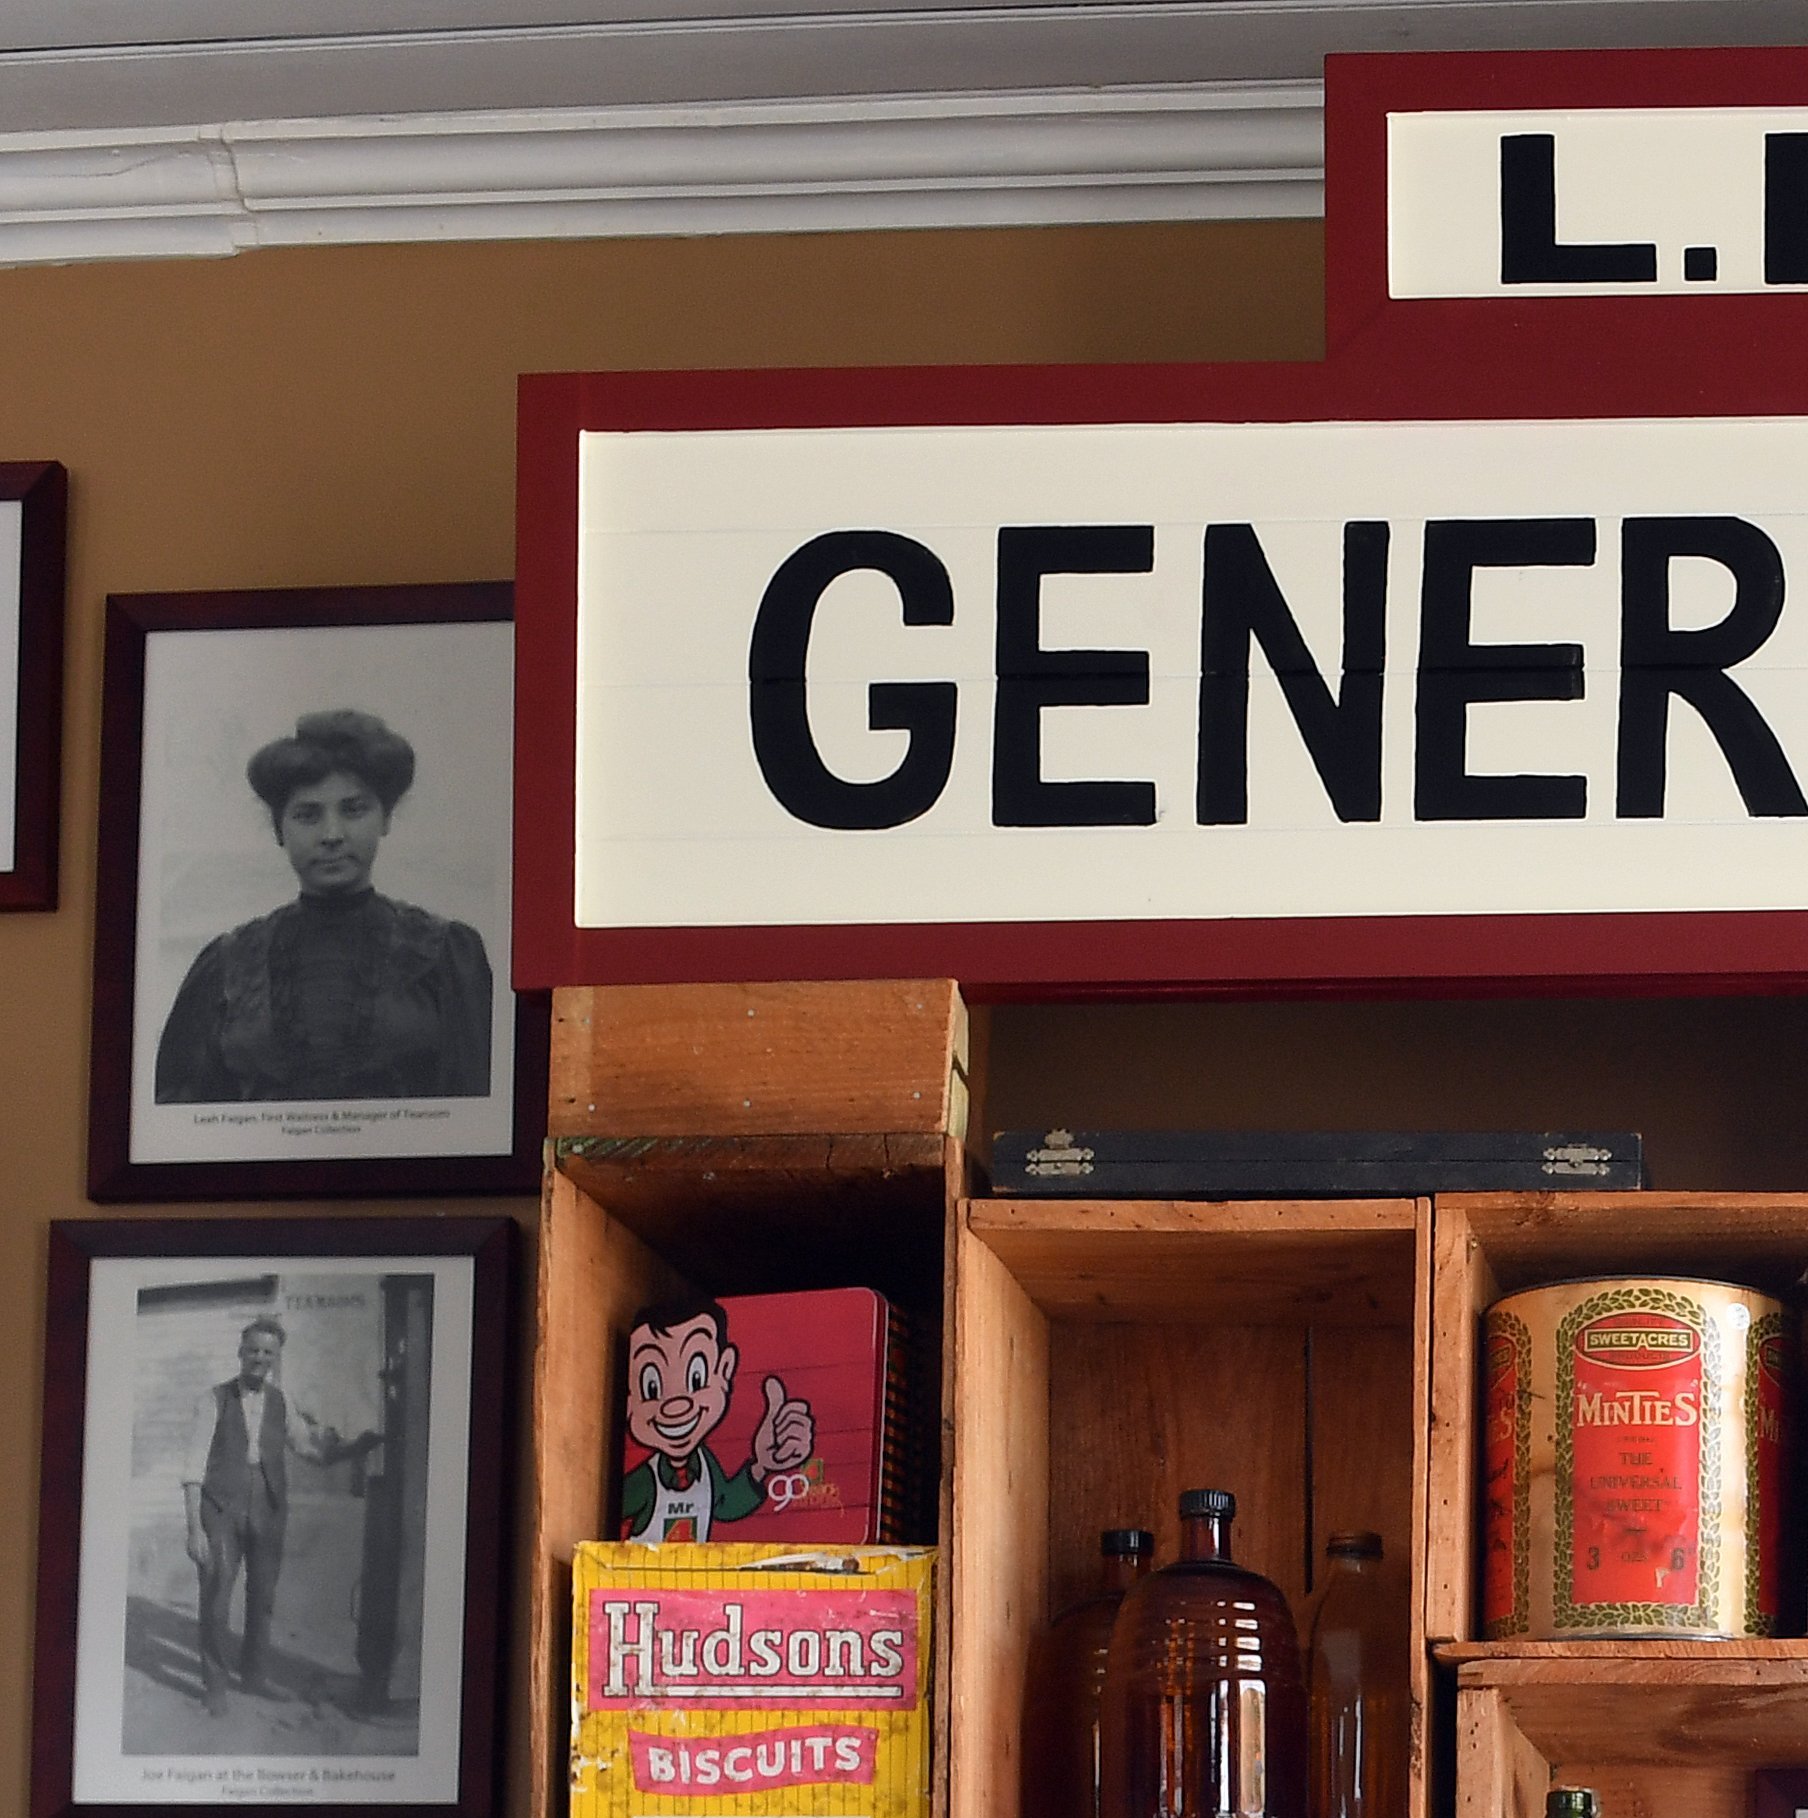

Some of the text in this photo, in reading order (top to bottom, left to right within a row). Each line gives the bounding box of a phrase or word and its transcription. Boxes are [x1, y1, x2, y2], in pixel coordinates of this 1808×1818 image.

[1501, 133, 1718, 285] L.
[1589, 1331, 1690, 1349] SWEETACRES
[667, 1502, 695, 1515] Mr
[600, 1601, 905, 1698] Hudsons
[647, 1736, 863, 1787] BISCUITS
